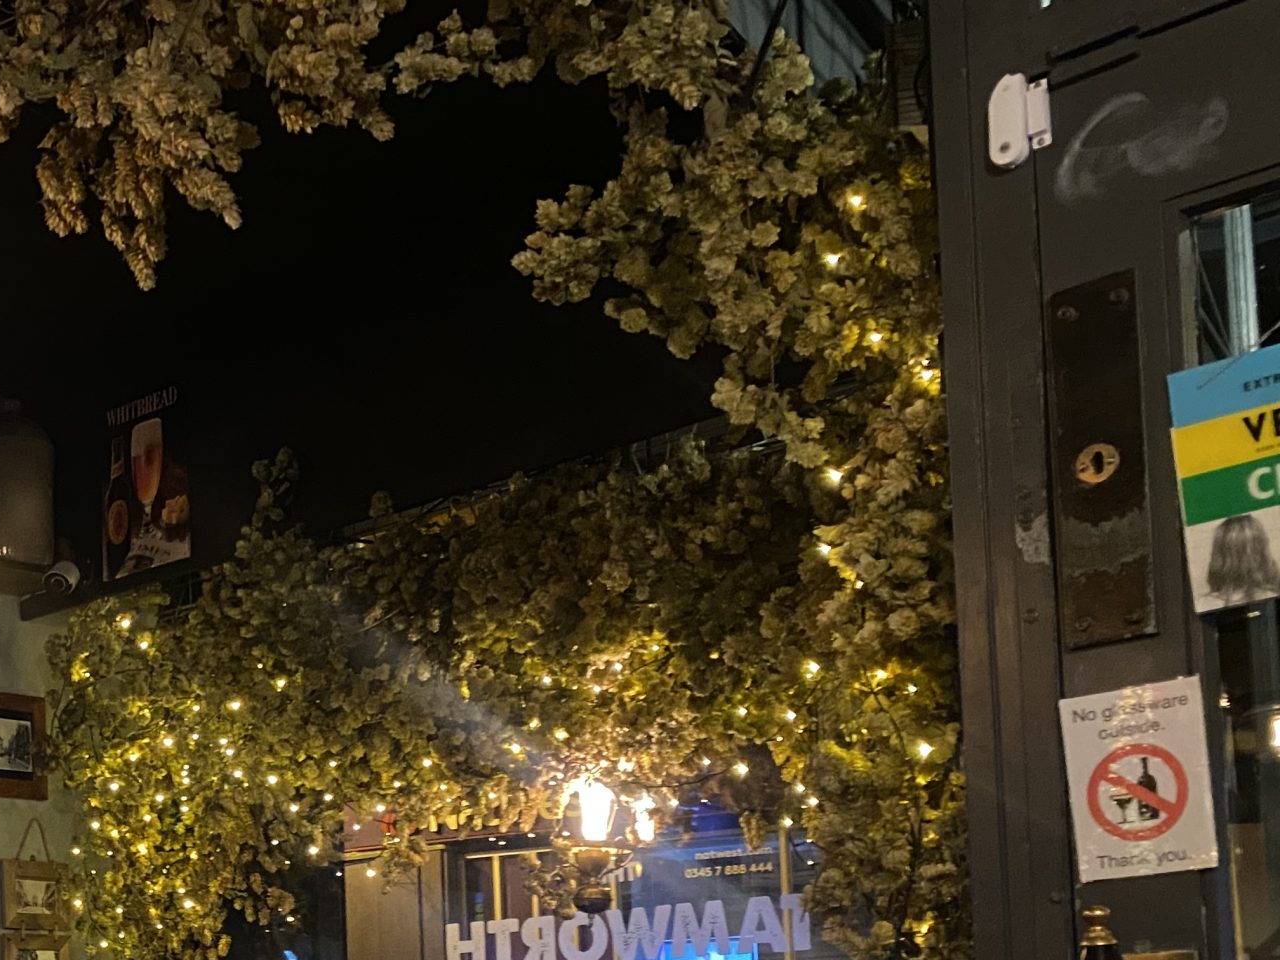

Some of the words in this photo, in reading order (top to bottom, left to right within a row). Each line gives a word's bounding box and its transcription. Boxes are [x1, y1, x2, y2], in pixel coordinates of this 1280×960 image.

[106, 386, 178, 427] WHITBREAD
[1072, 709, 1097, 723] No
[1096, 854, 1150, 869] Thank
[684, 866, 713, 879] 0345
[715, 865, 721, 876] 7
[724, 864, 747, 876] 888
[749, 862, 773, 873] 444
